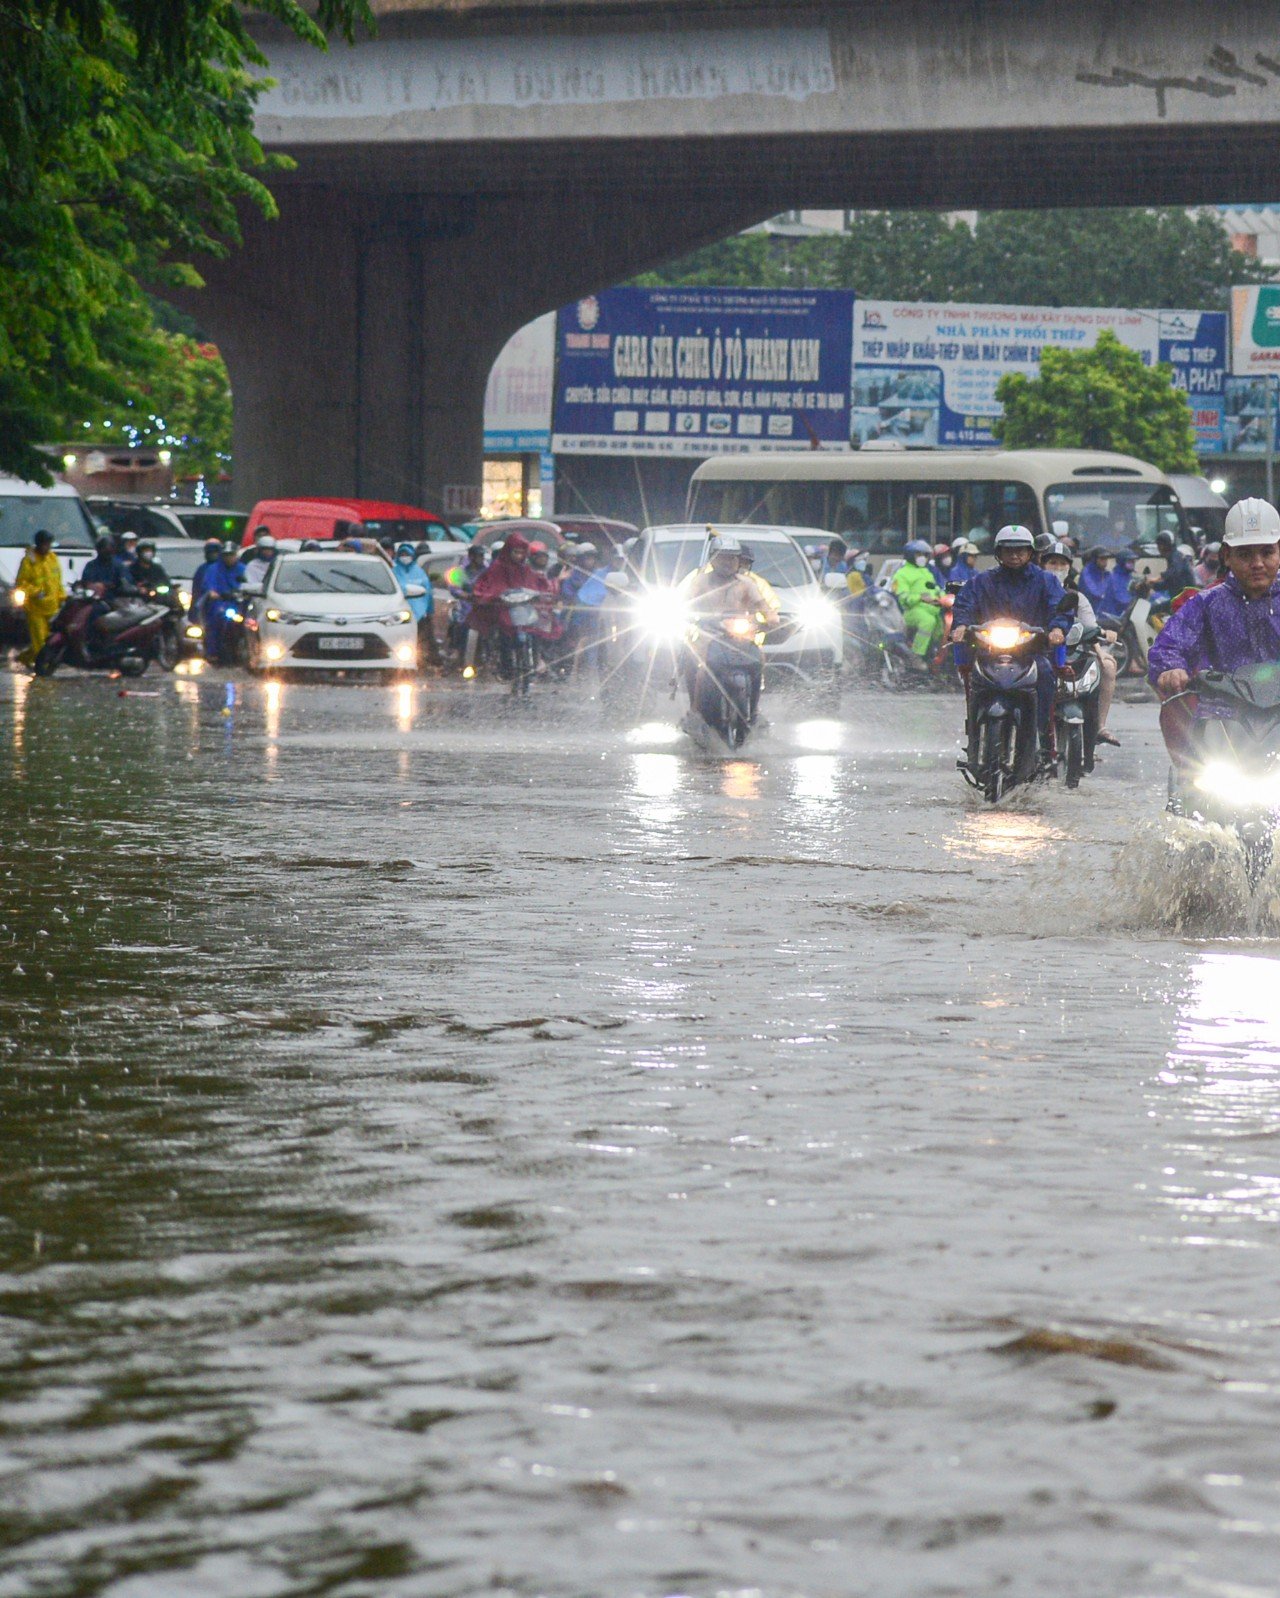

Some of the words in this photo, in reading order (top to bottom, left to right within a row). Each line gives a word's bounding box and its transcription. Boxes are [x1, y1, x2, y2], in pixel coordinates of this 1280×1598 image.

[936, 323, 966, 336] NHÀ
[971, 324, 1009, 338] PHÂN
[1014, 324, 1046, 338] PHỐI
[1052, 327, 1086, 340] THÉP
[614, 335, 648, 378] GARA
[713, 327, 722, 380] Ô
[725, 327, 742, 381] TÔ
[790, 339, 820, 382] NAM
